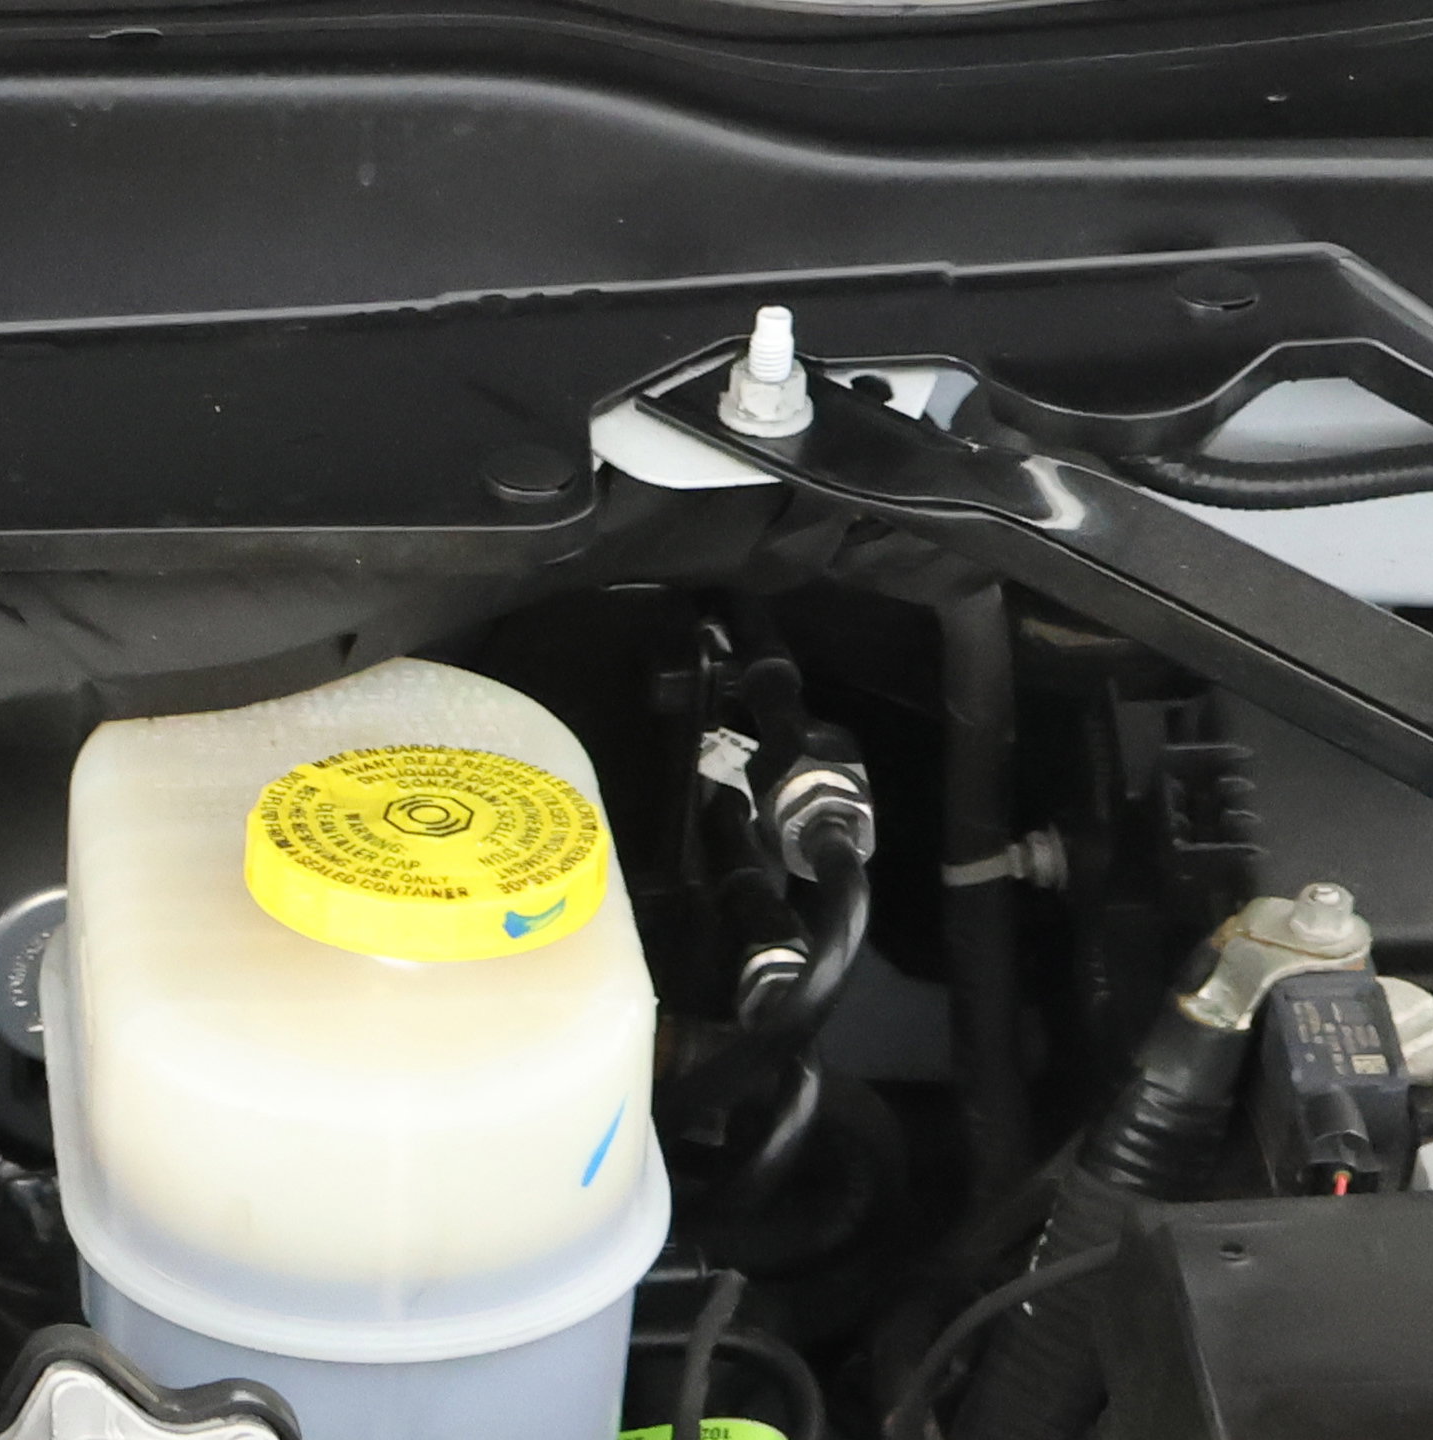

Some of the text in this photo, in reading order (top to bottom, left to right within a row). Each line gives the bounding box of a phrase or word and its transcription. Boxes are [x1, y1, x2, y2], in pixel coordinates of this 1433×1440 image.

[341, 758, 394, 776] AVANT
[403, 756, 427, 765] DE
[434, 757, 456, 765] LE
[382, 857, 421, 870] CAP
[294, 855, 356, 884] SEALED
[360, 879, 469, 899] CONTAINER
[400, 874, 449, 884] ONLY
